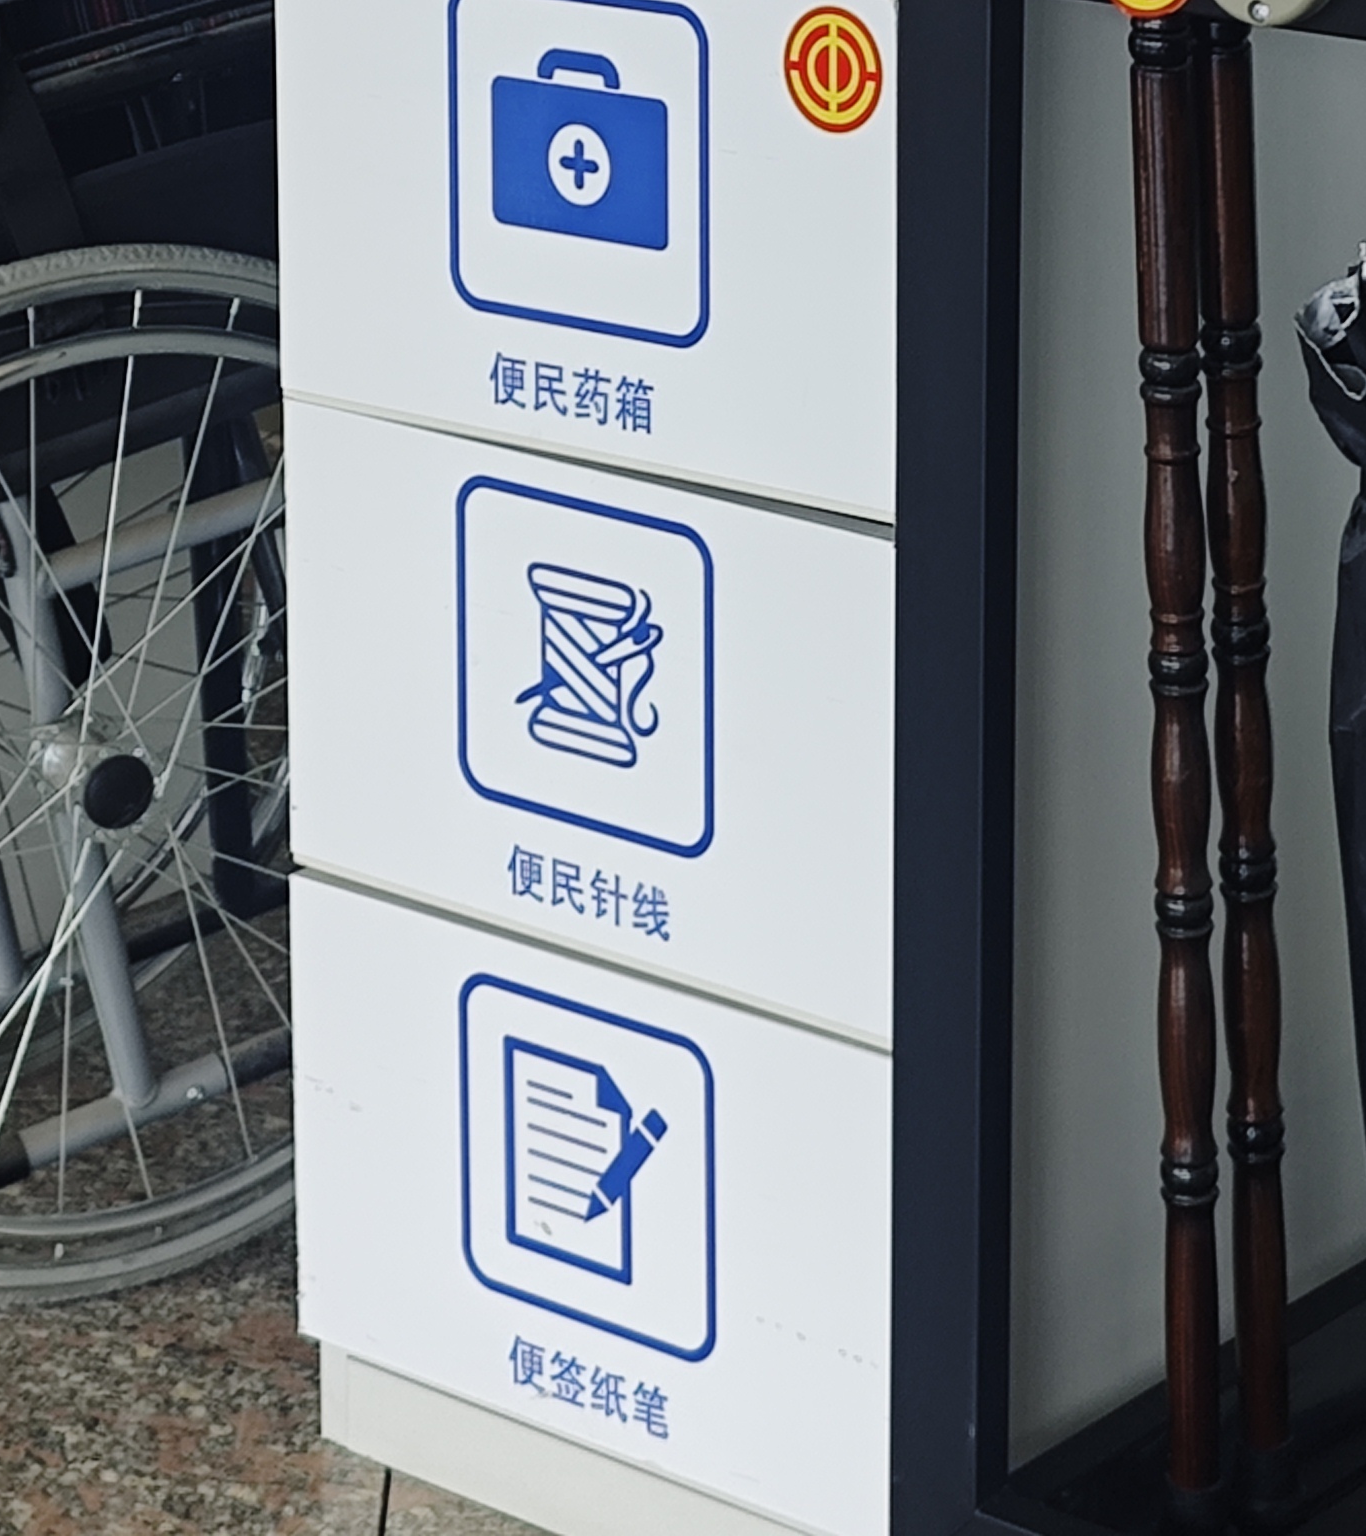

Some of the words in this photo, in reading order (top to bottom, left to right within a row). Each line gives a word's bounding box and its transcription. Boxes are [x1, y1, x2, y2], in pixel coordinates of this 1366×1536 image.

[489, 351, 655, 435] 便民药箱
[506, 844, 672, 943] 便民针线
[508, 1335, 671, 1440] 便签纸笔
